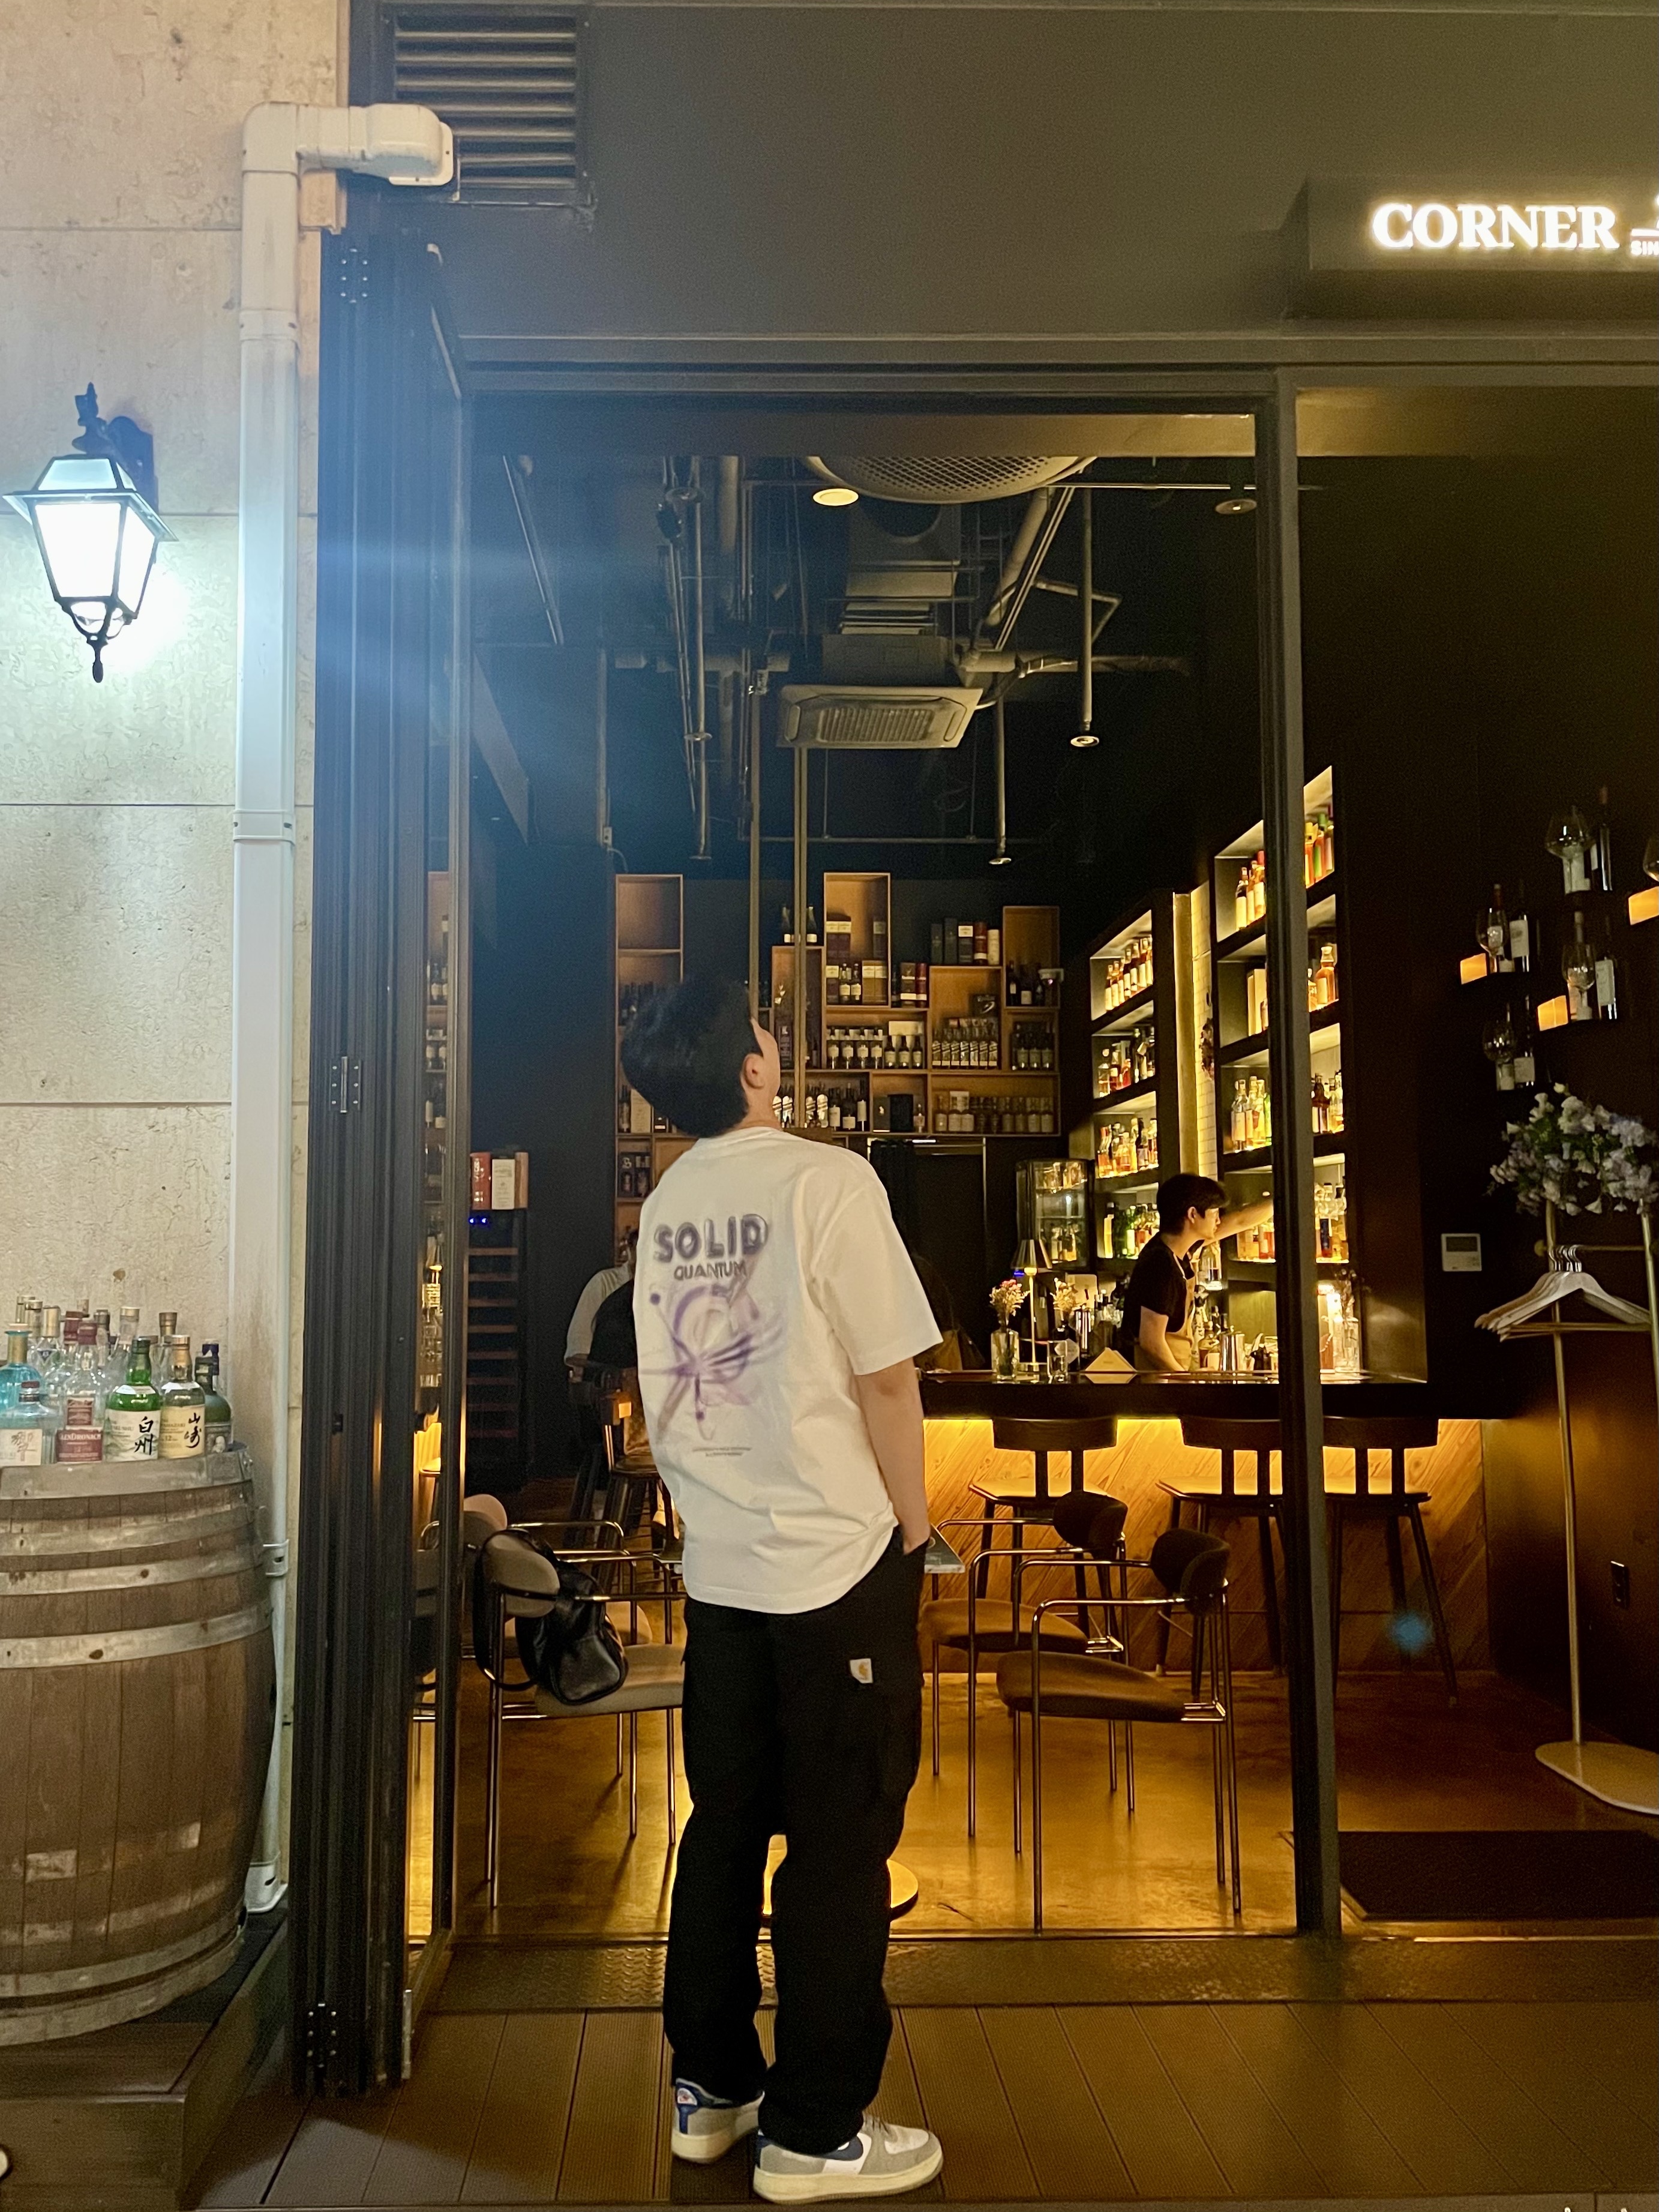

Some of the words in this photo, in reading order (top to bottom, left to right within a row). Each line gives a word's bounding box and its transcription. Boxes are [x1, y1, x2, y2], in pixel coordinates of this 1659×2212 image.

[1372, 203, 1620, 248] CORNER
[653, 1213, 769, 1263] SOLID
[674, 1260, 747, 1281] QUANTUM
[134, 1416, 154, 1455] 白州
